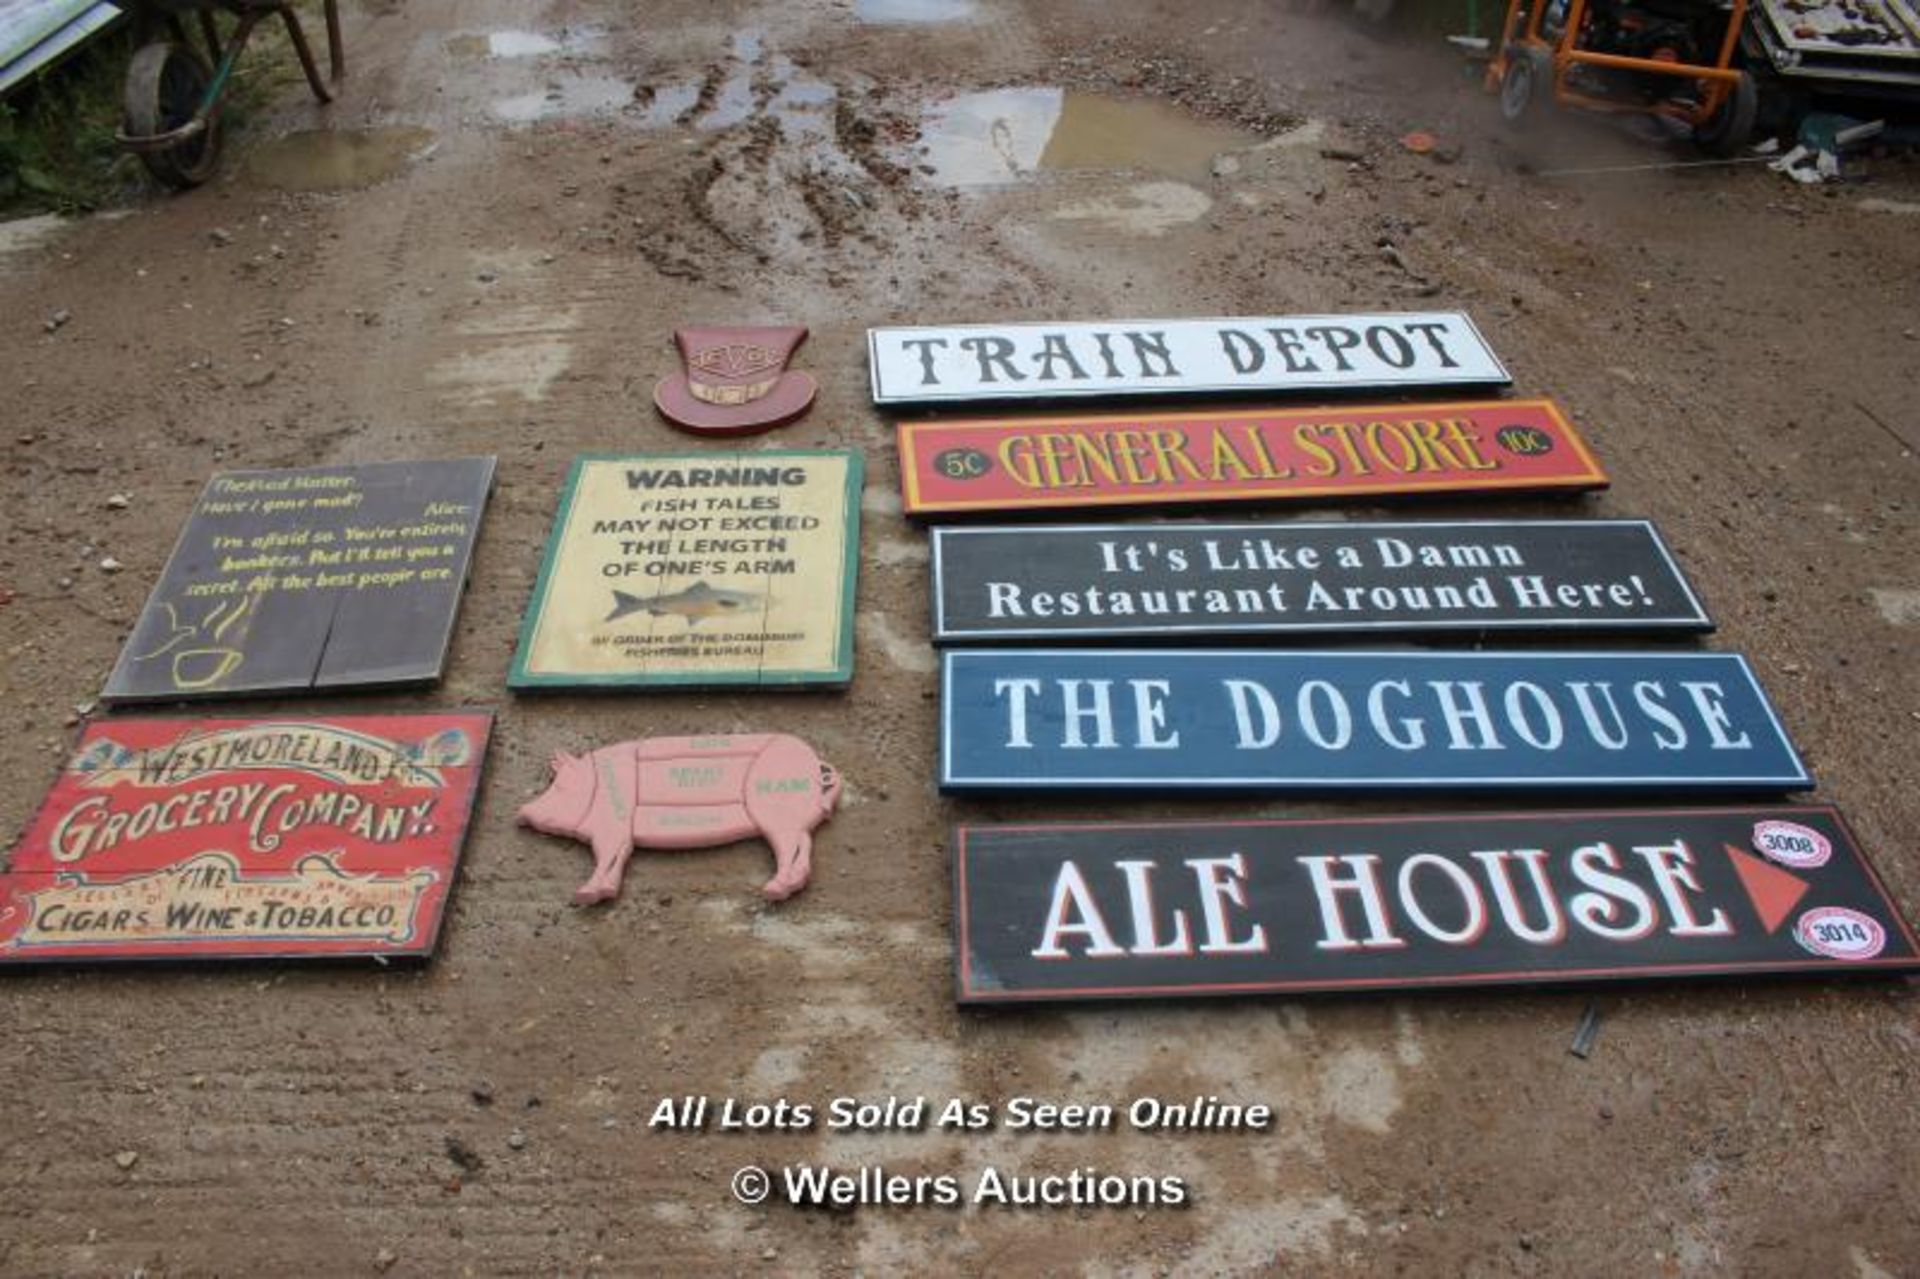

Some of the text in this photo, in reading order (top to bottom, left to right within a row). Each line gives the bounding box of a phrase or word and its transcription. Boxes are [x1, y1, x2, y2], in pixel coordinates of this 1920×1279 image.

[902, 323, 1460, 385] TRAIN DEPOT
[999, 424, 1290, 488] GENERAL
[1293, 418, 1500, 476] STORE
[626, 467, 807, 489] WARNING
[640, 496, 781, 513] FISH TALES
[592, 515, 820, 535] MAY NOT EXCEED
[252, 529, 310, 550] afraid
[620, 538, 786, 556] THE LENGTH
[408, 546, 438, 562] you
[1097, 538, 1525, 573] It's Like a Damn
[602, 558, 796, 578] OF ONE'S ARM
[281, 573, 313, 590] the
[316, 571, 355, 588] best
[985, 574, 1655, 618] Restaurant Around Here!
[995, 678, 1753, 751] THE DOGHOUSE
[51, 781, 264, 863] GROCERY
[1764, 834, 1815, 854] 3008
[176, 864, 227, 890] FINE
[1031, 839, 1737, 960] ALE HOUSE
[166, 902, 242, 930] WINE
[1814, 924, 1868, 943] 3014
